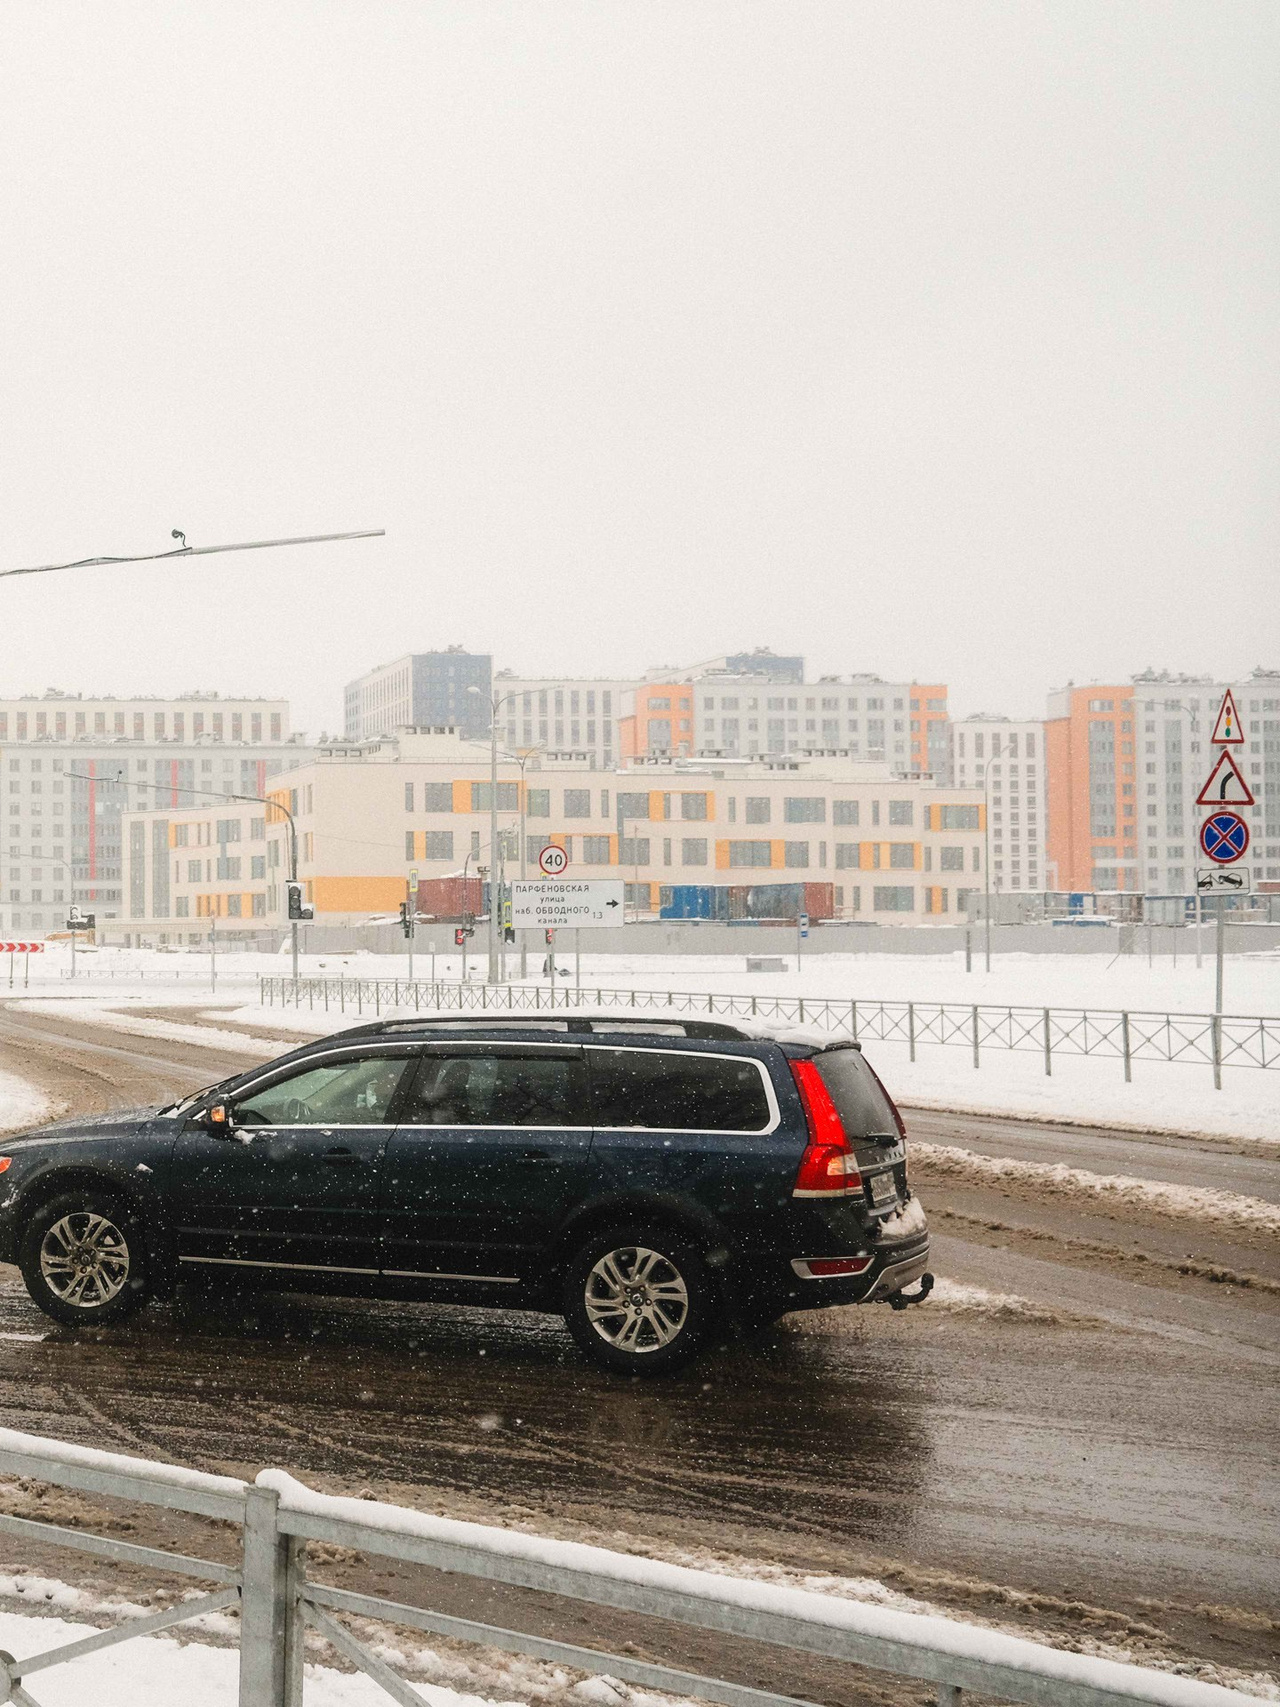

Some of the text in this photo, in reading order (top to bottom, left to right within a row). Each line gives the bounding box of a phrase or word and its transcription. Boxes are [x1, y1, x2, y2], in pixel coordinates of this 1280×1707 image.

[545, 854, 562, 866] 40
[540, 896, 565, 904] улица
[515, 906, 590, 914] наб. ОБВОДНОГО
